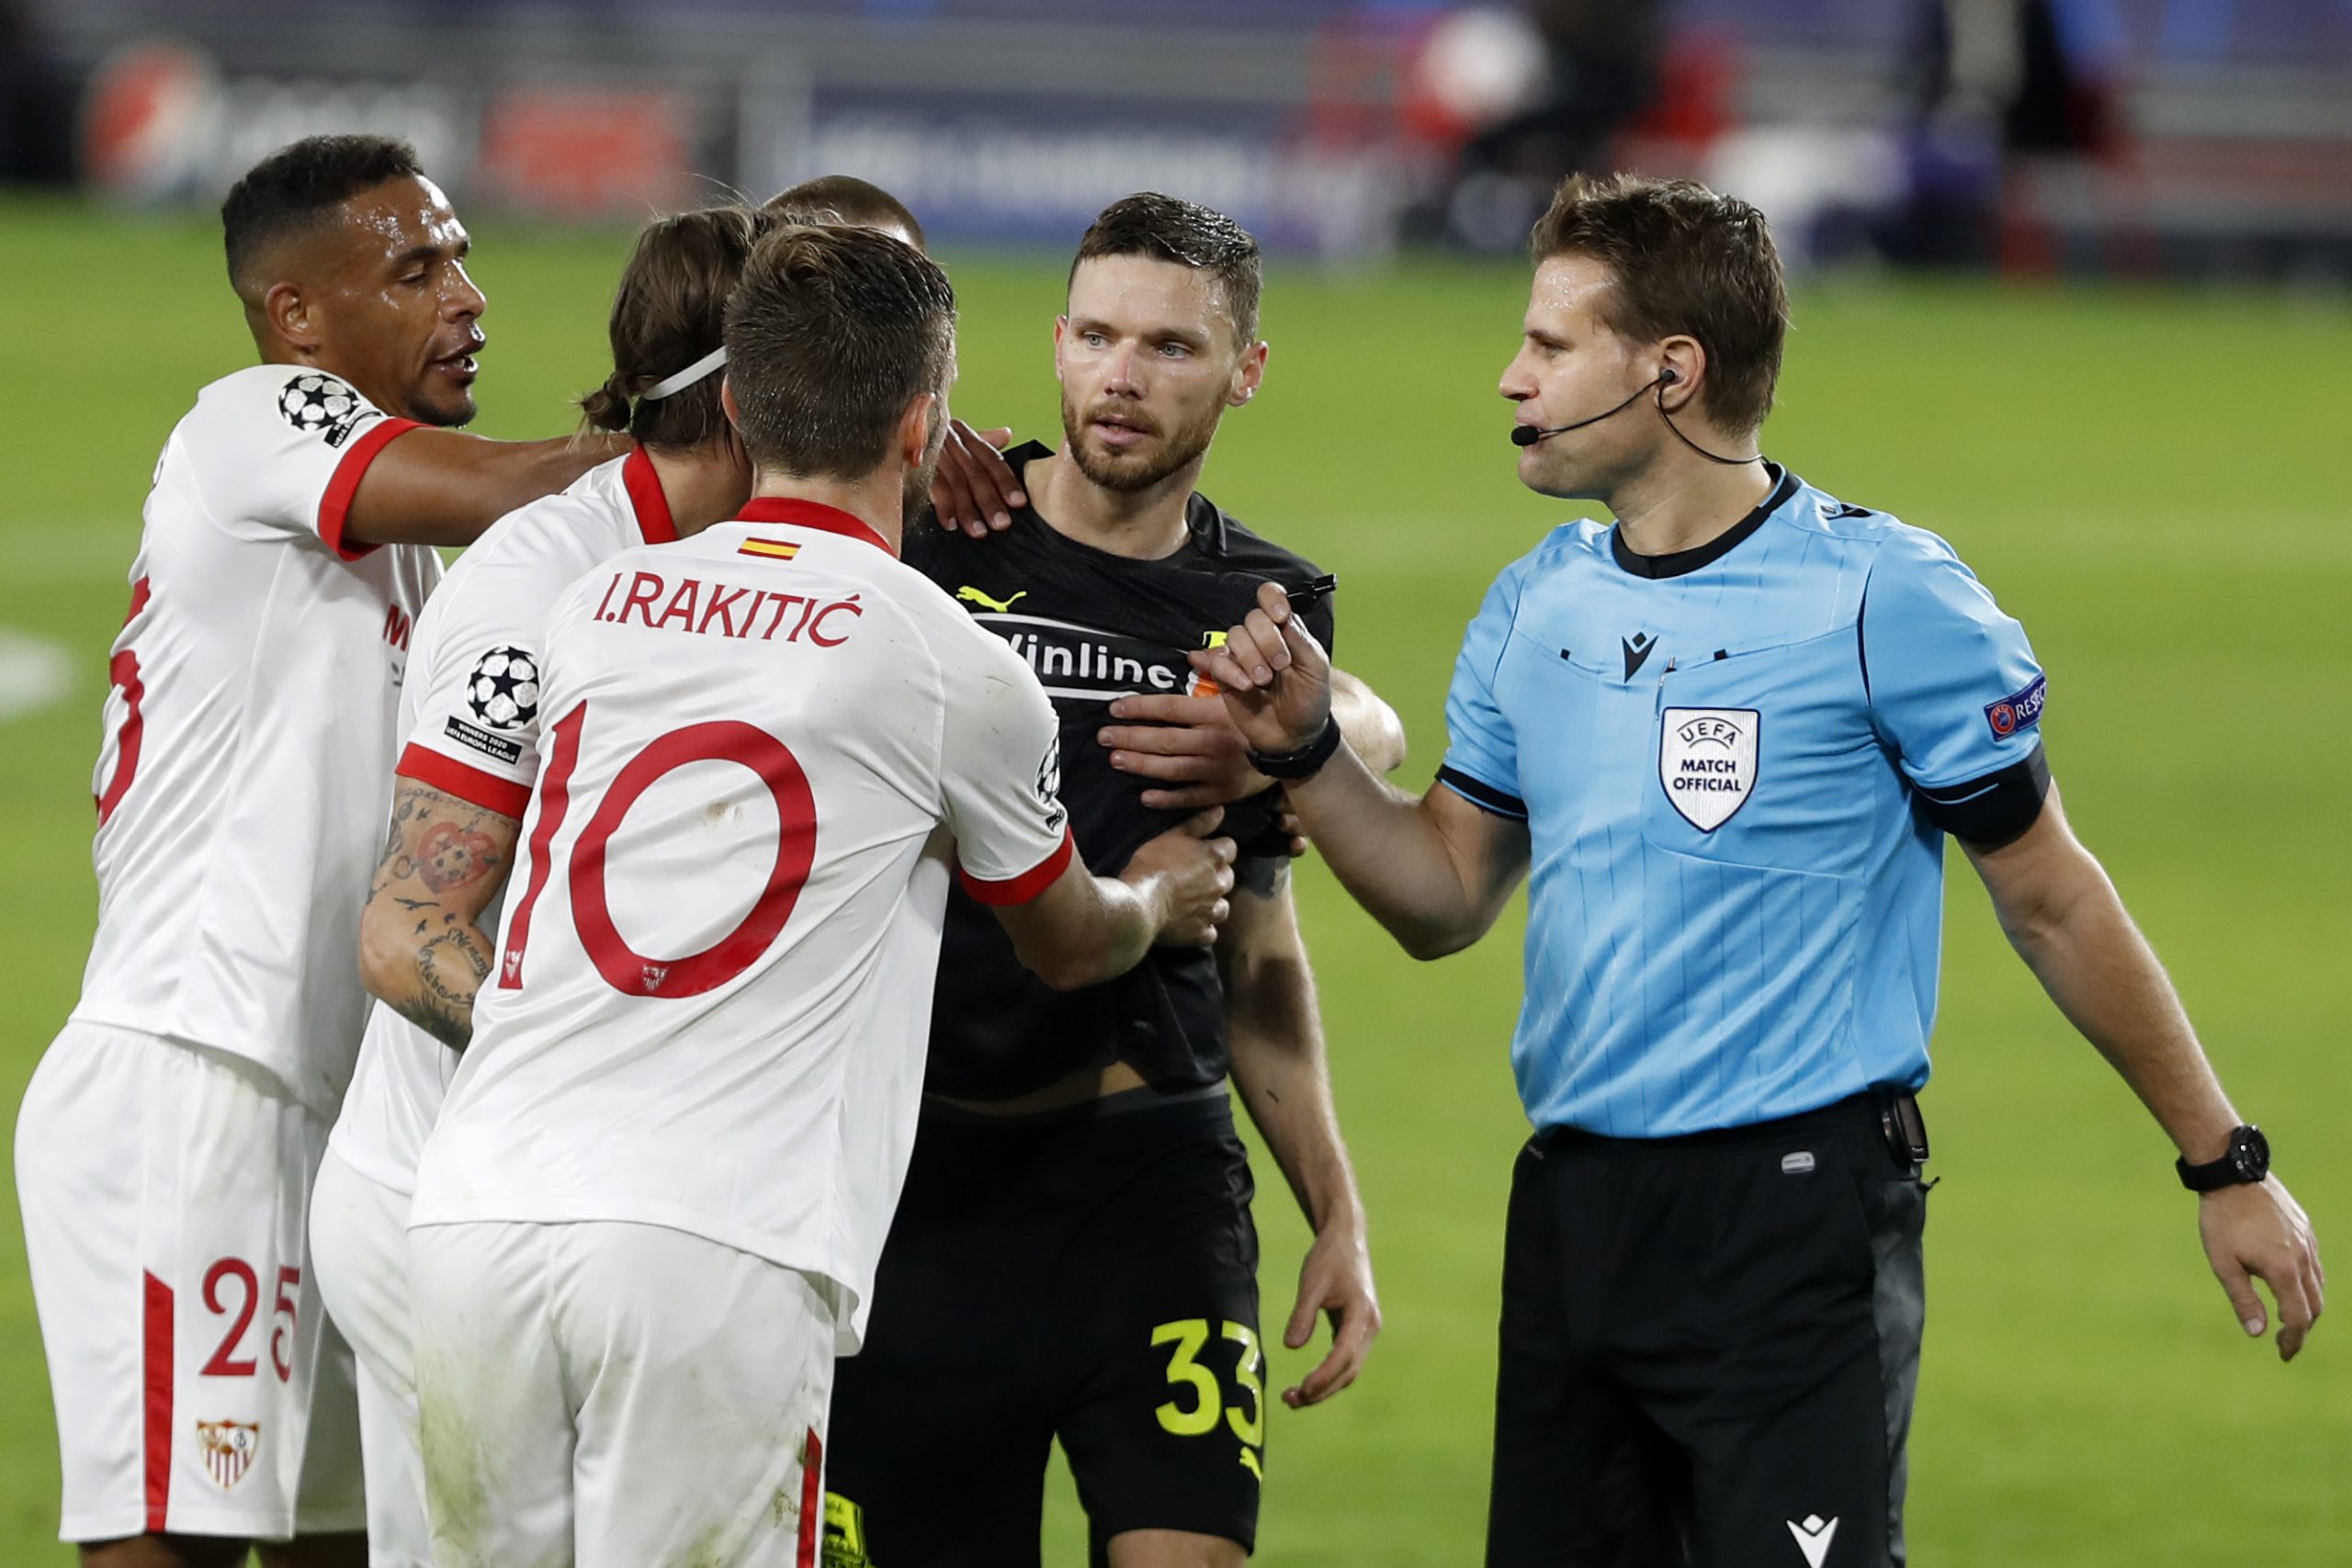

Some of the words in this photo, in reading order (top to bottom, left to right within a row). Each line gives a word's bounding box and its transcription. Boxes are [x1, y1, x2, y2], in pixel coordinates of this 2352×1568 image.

[593, 571, 864, 648] I.RAKITIĆ
[447, 727, 460, 739] UEFA
[460, 734, 487, 750] EUROPA
[487, 746, 516, 761] LEAGUE
[458, 722, 488, 741] WINNERS
[489, 738, 508, 749] 2020
[1680, 722, 1736, 745] UEFA
[1680, 759, 1736, 773] MATCH
[1673, 777, 1742, 792] OFFICIAL
[498, 699, 817, 999] 10
[199, 1256, 300, 1383] 25
[1150, 1318, 1263, 1448] 33
